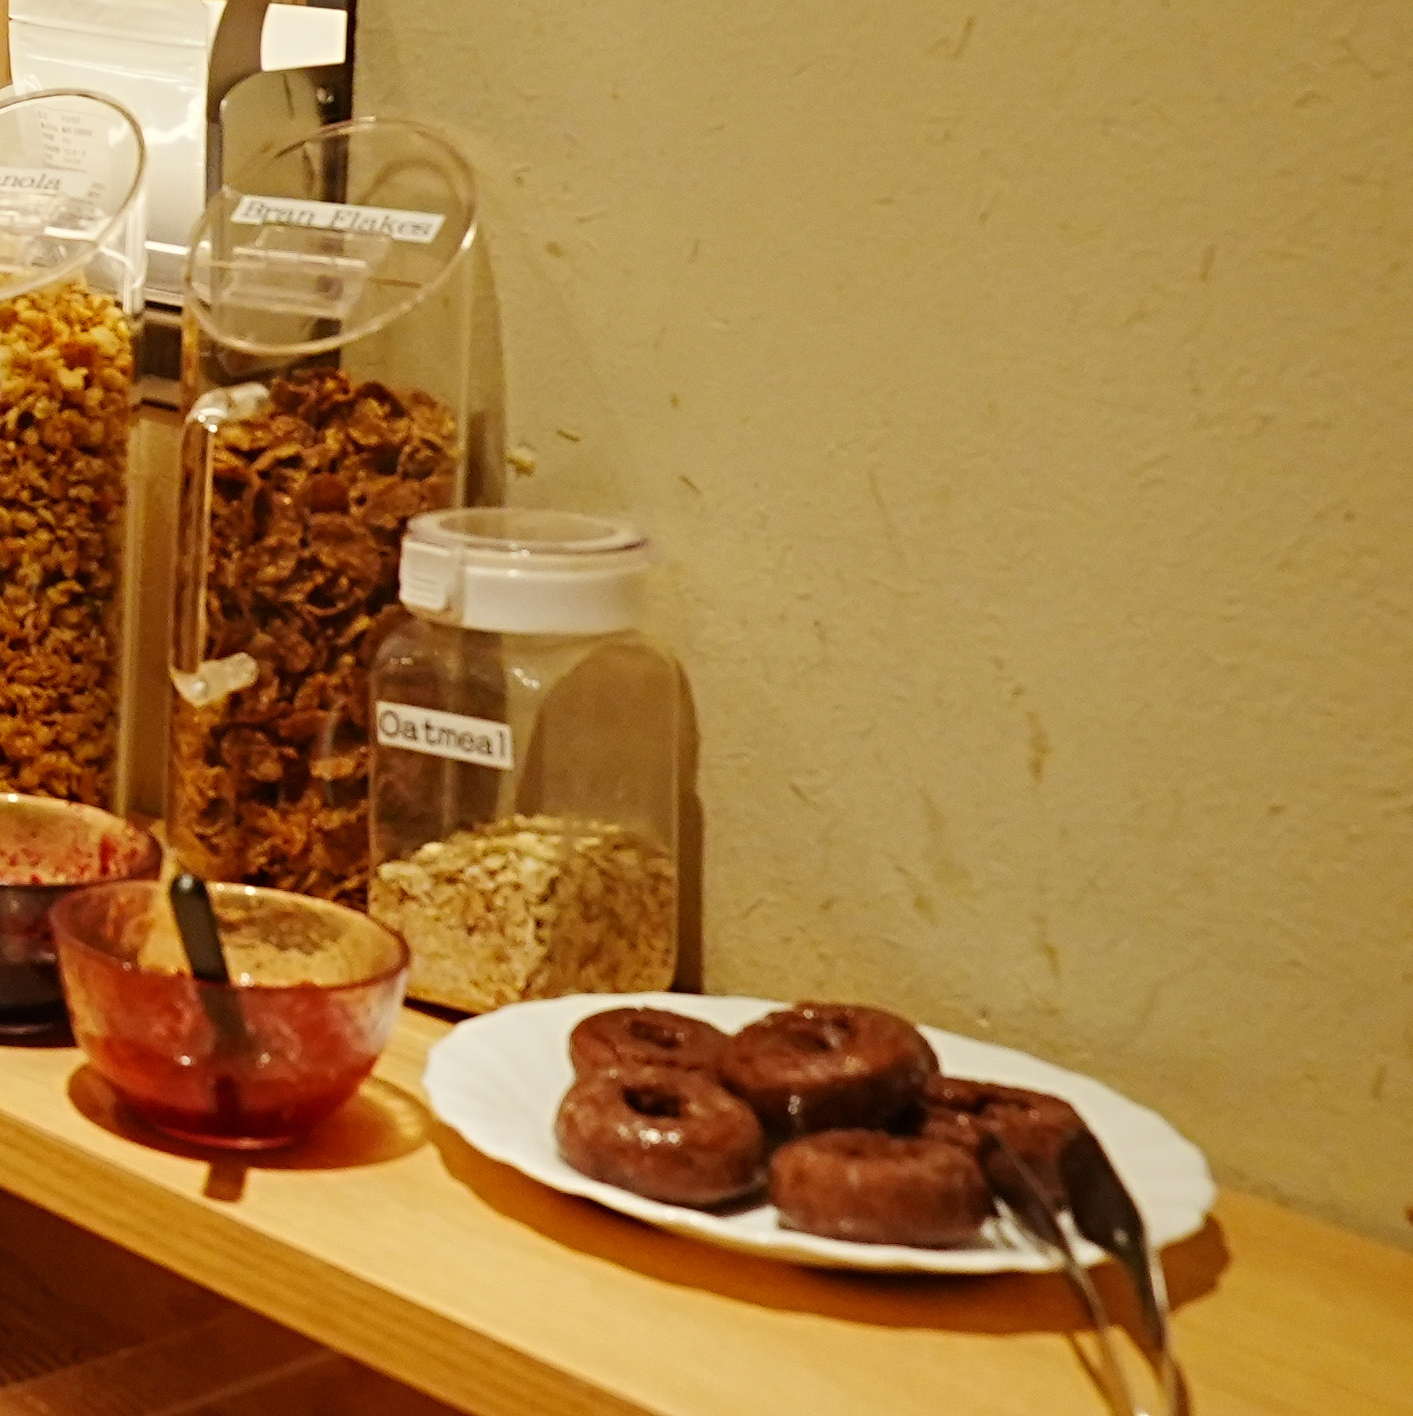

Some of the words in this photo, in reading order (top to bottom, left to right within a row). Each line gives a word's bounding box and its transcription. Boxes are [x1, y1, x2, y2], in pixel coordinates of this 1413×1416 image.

[243, 200, 314, 225] Bran
[331, 209, 434, 236] Flakes
[379, 710, 506, 758] Oatmeal
